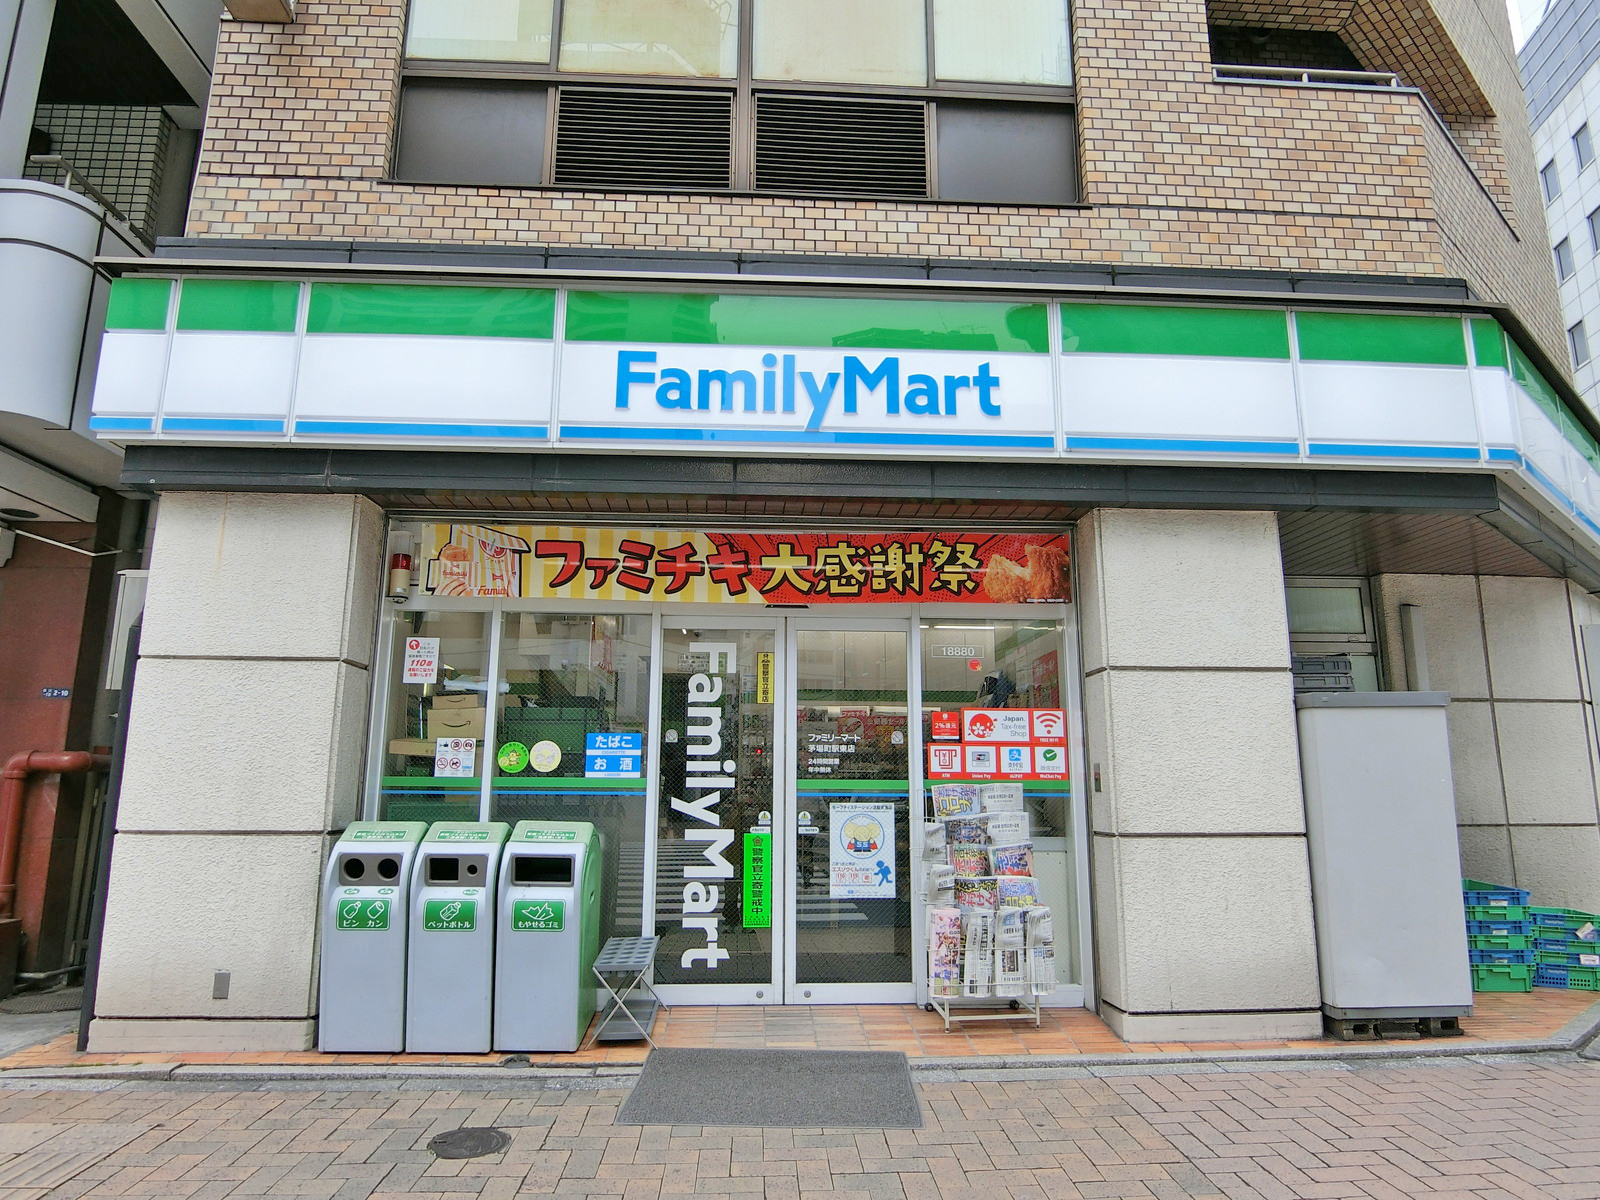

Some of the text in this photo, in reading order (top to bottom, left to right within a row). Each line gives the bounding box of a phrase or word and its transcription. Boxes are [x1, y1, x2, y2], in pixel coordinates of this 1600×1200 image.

[614, 349, 1003, 433] FamilyMart
[534, 538, 984, 597] ファミチキ大感謝祭
[941, 647, 975, 656] 18880
[1001, 722, 1027, 730] Tax-free
[807, 733, 861, 743] ファミリーマート
[1010, 730, 1027, 738] Shop
[595, 735, 633, 748] たばこ
[670, 642, 737, 969] FamilyMart
